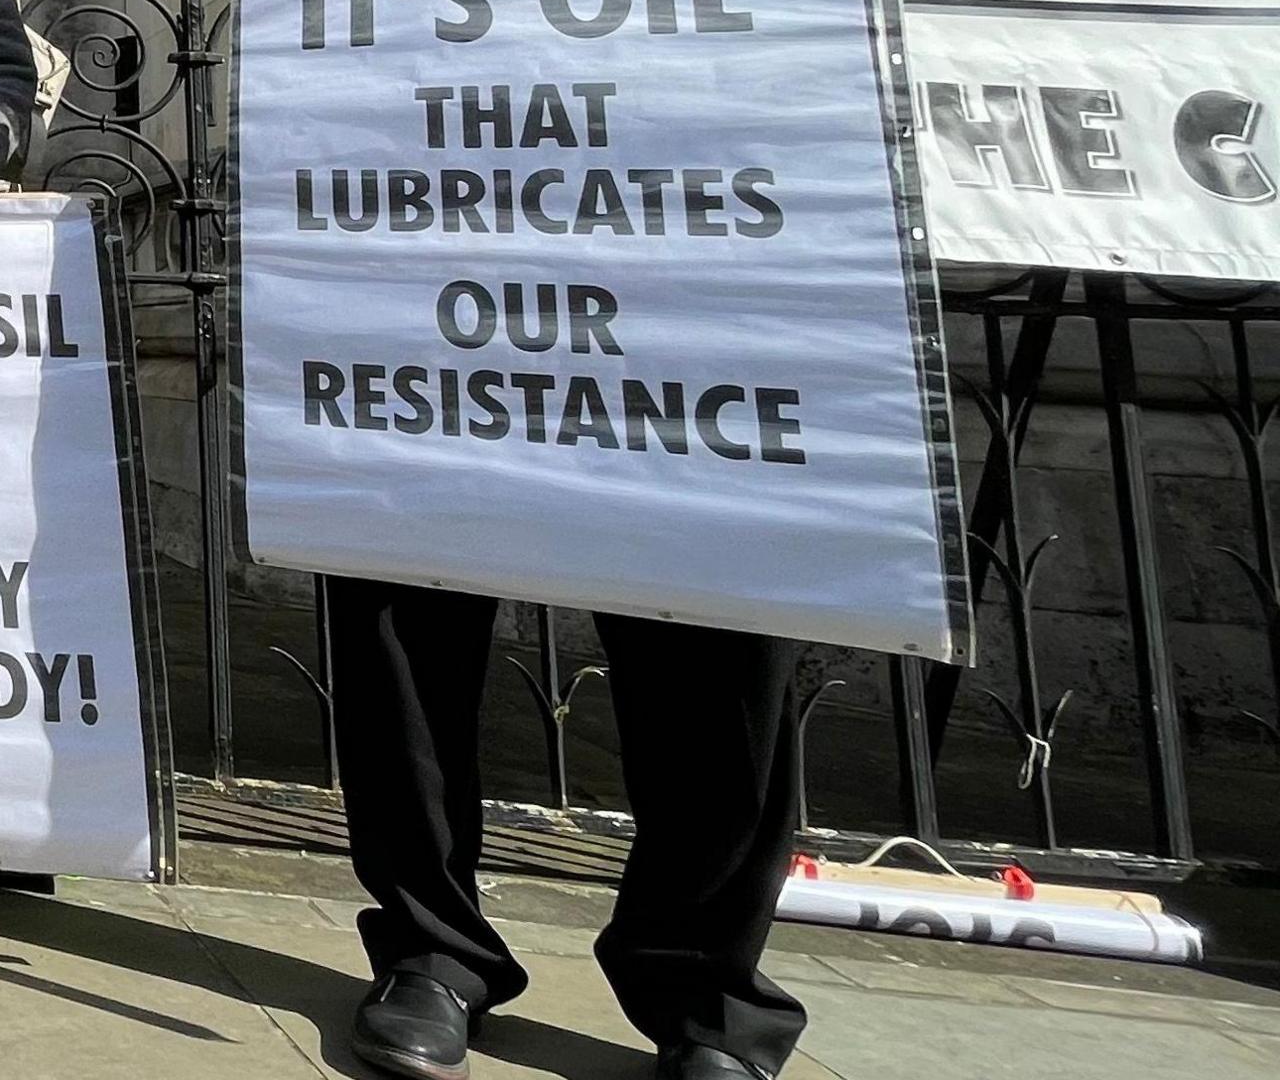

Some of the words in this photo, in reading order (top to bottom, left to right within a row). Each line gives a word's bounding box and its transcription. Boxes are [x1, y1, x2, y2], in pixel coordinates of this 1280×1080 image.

[413, 82, 617, 150] THAT
[914, 81, 1142, 201] HE
[294, 167, 785, 239] LUBRICATES
[435, 279, 625, 357] OUR
[302, 360, 808, 466] RESISTANCE
